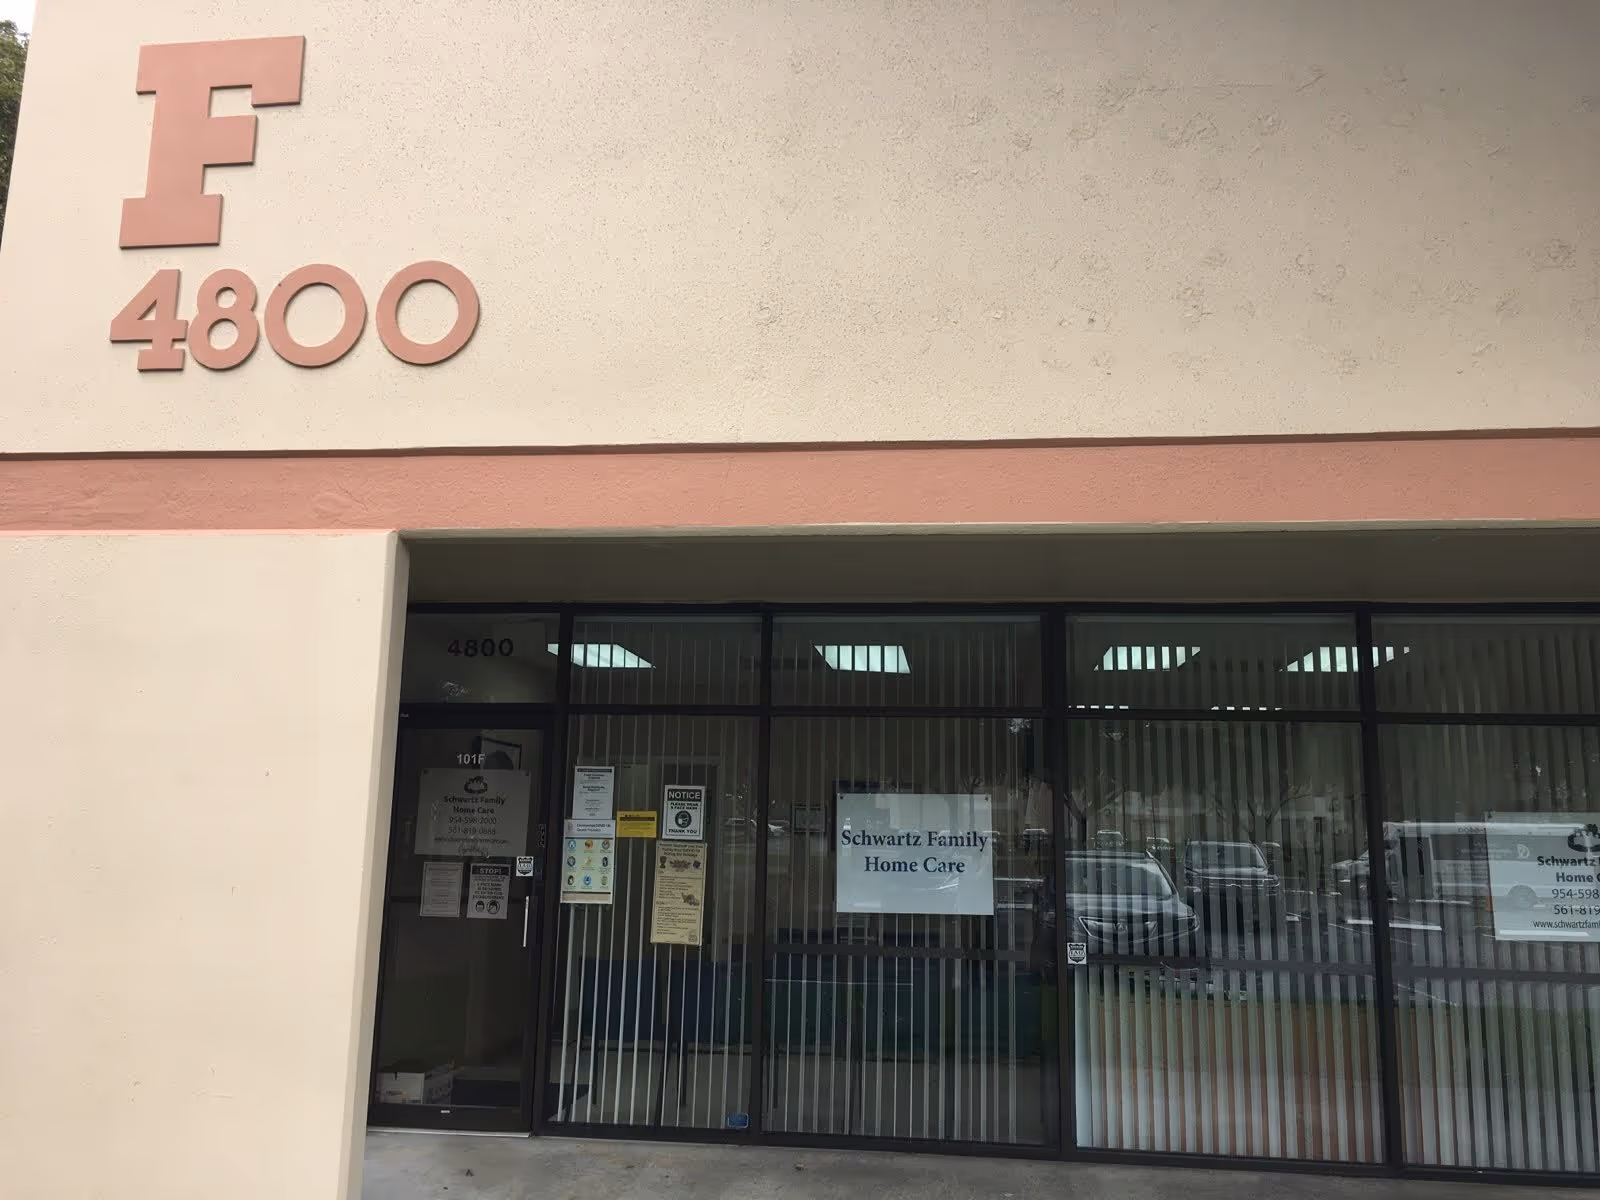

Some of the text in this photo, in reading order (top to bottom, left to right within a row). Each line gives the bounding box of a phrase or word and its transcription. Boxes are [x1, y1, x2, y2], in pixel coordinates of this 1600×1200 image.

[119, 35, 306, 249] F
[109, 260, 481, 372] 4800
[447, 637, 514, 658] 4800
[456, 753, 486, 765] 101F
[668, 791, 701, 800] NOTICE
[841, 829, 989, 852] Schwartz Family
[864, 856, 965, 873] Home Care
[1537, 855, 1596, 867] Schwartz
[479, 867, 502, 875] STOP!
[1555, 872, 1594, 883] Home
